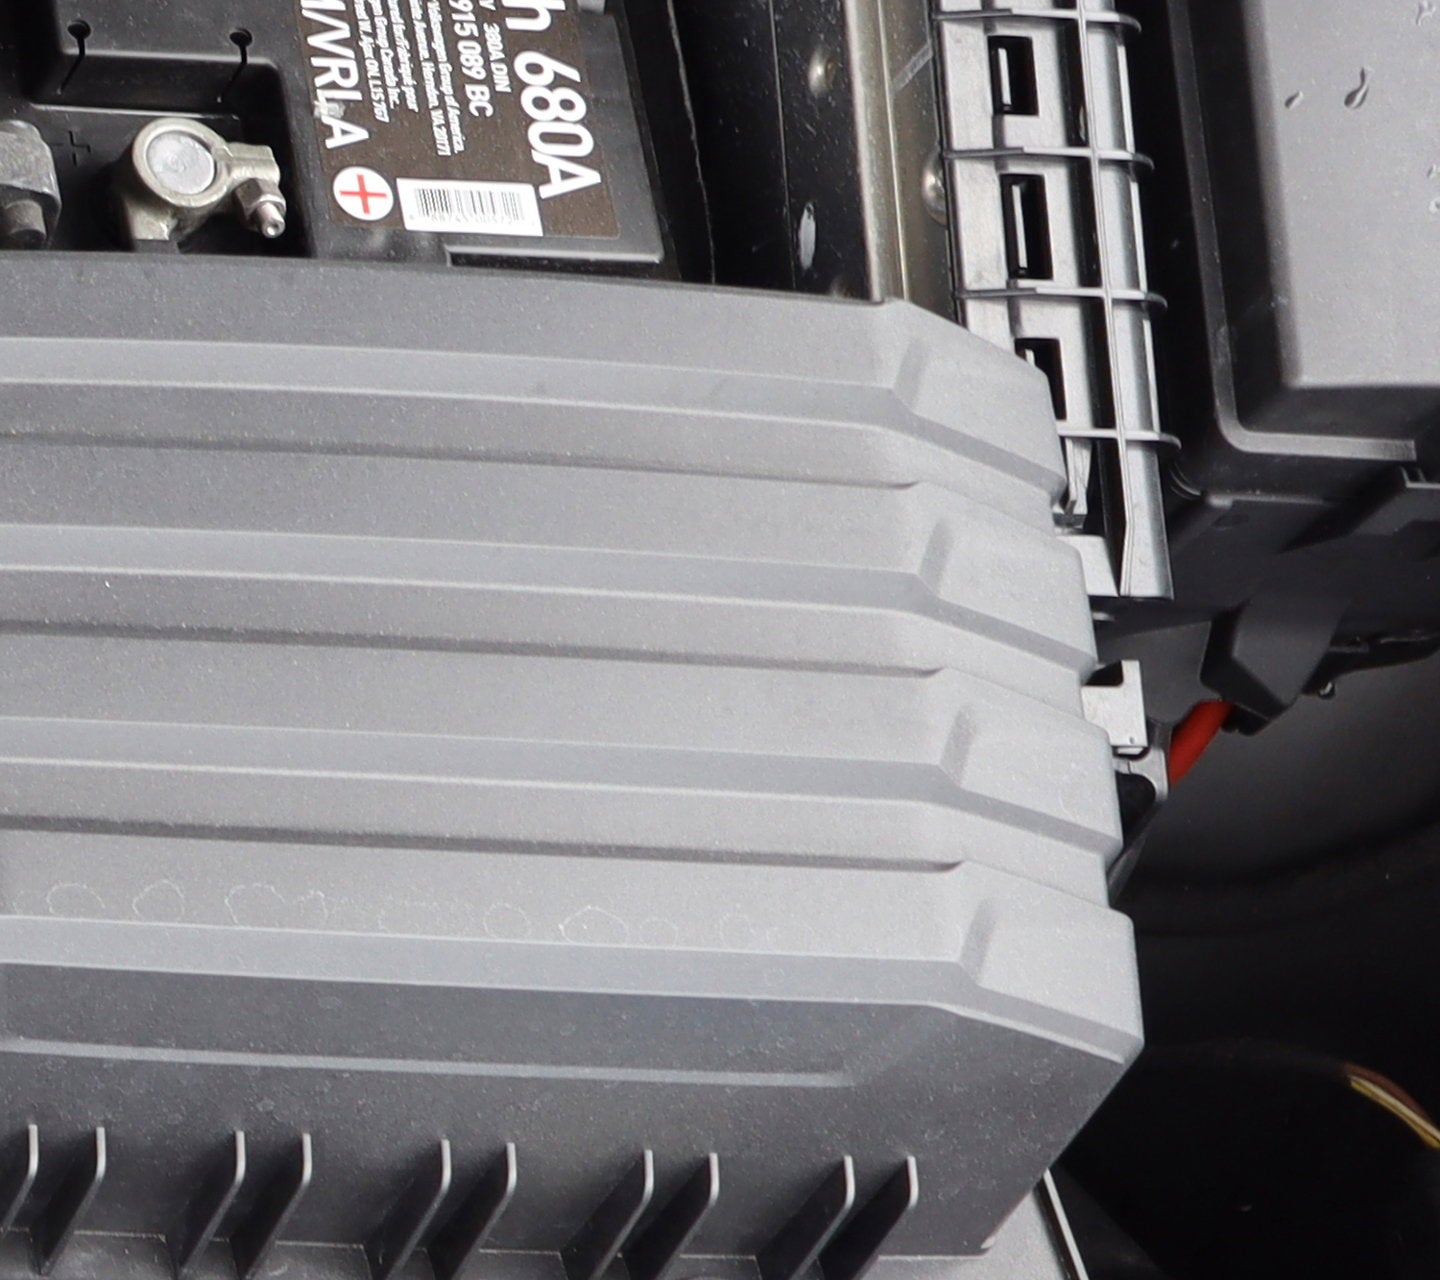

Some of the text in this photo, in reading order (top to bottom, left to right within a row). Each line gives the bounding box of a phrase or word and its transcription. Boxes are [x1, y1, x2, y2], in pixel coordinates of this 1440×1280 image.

[373, 17, 389, 49] Group
[426, 2, 448, 61] Volkswagen
[454, 39, 483, 78] 089
[436, 63, 454, 94] Group
[491, 62, 511, 92] DIN
[401, 86, 419, 112] pour
[465, 84, 493, 117] BC
[513, 51, 602, 200] 680A
